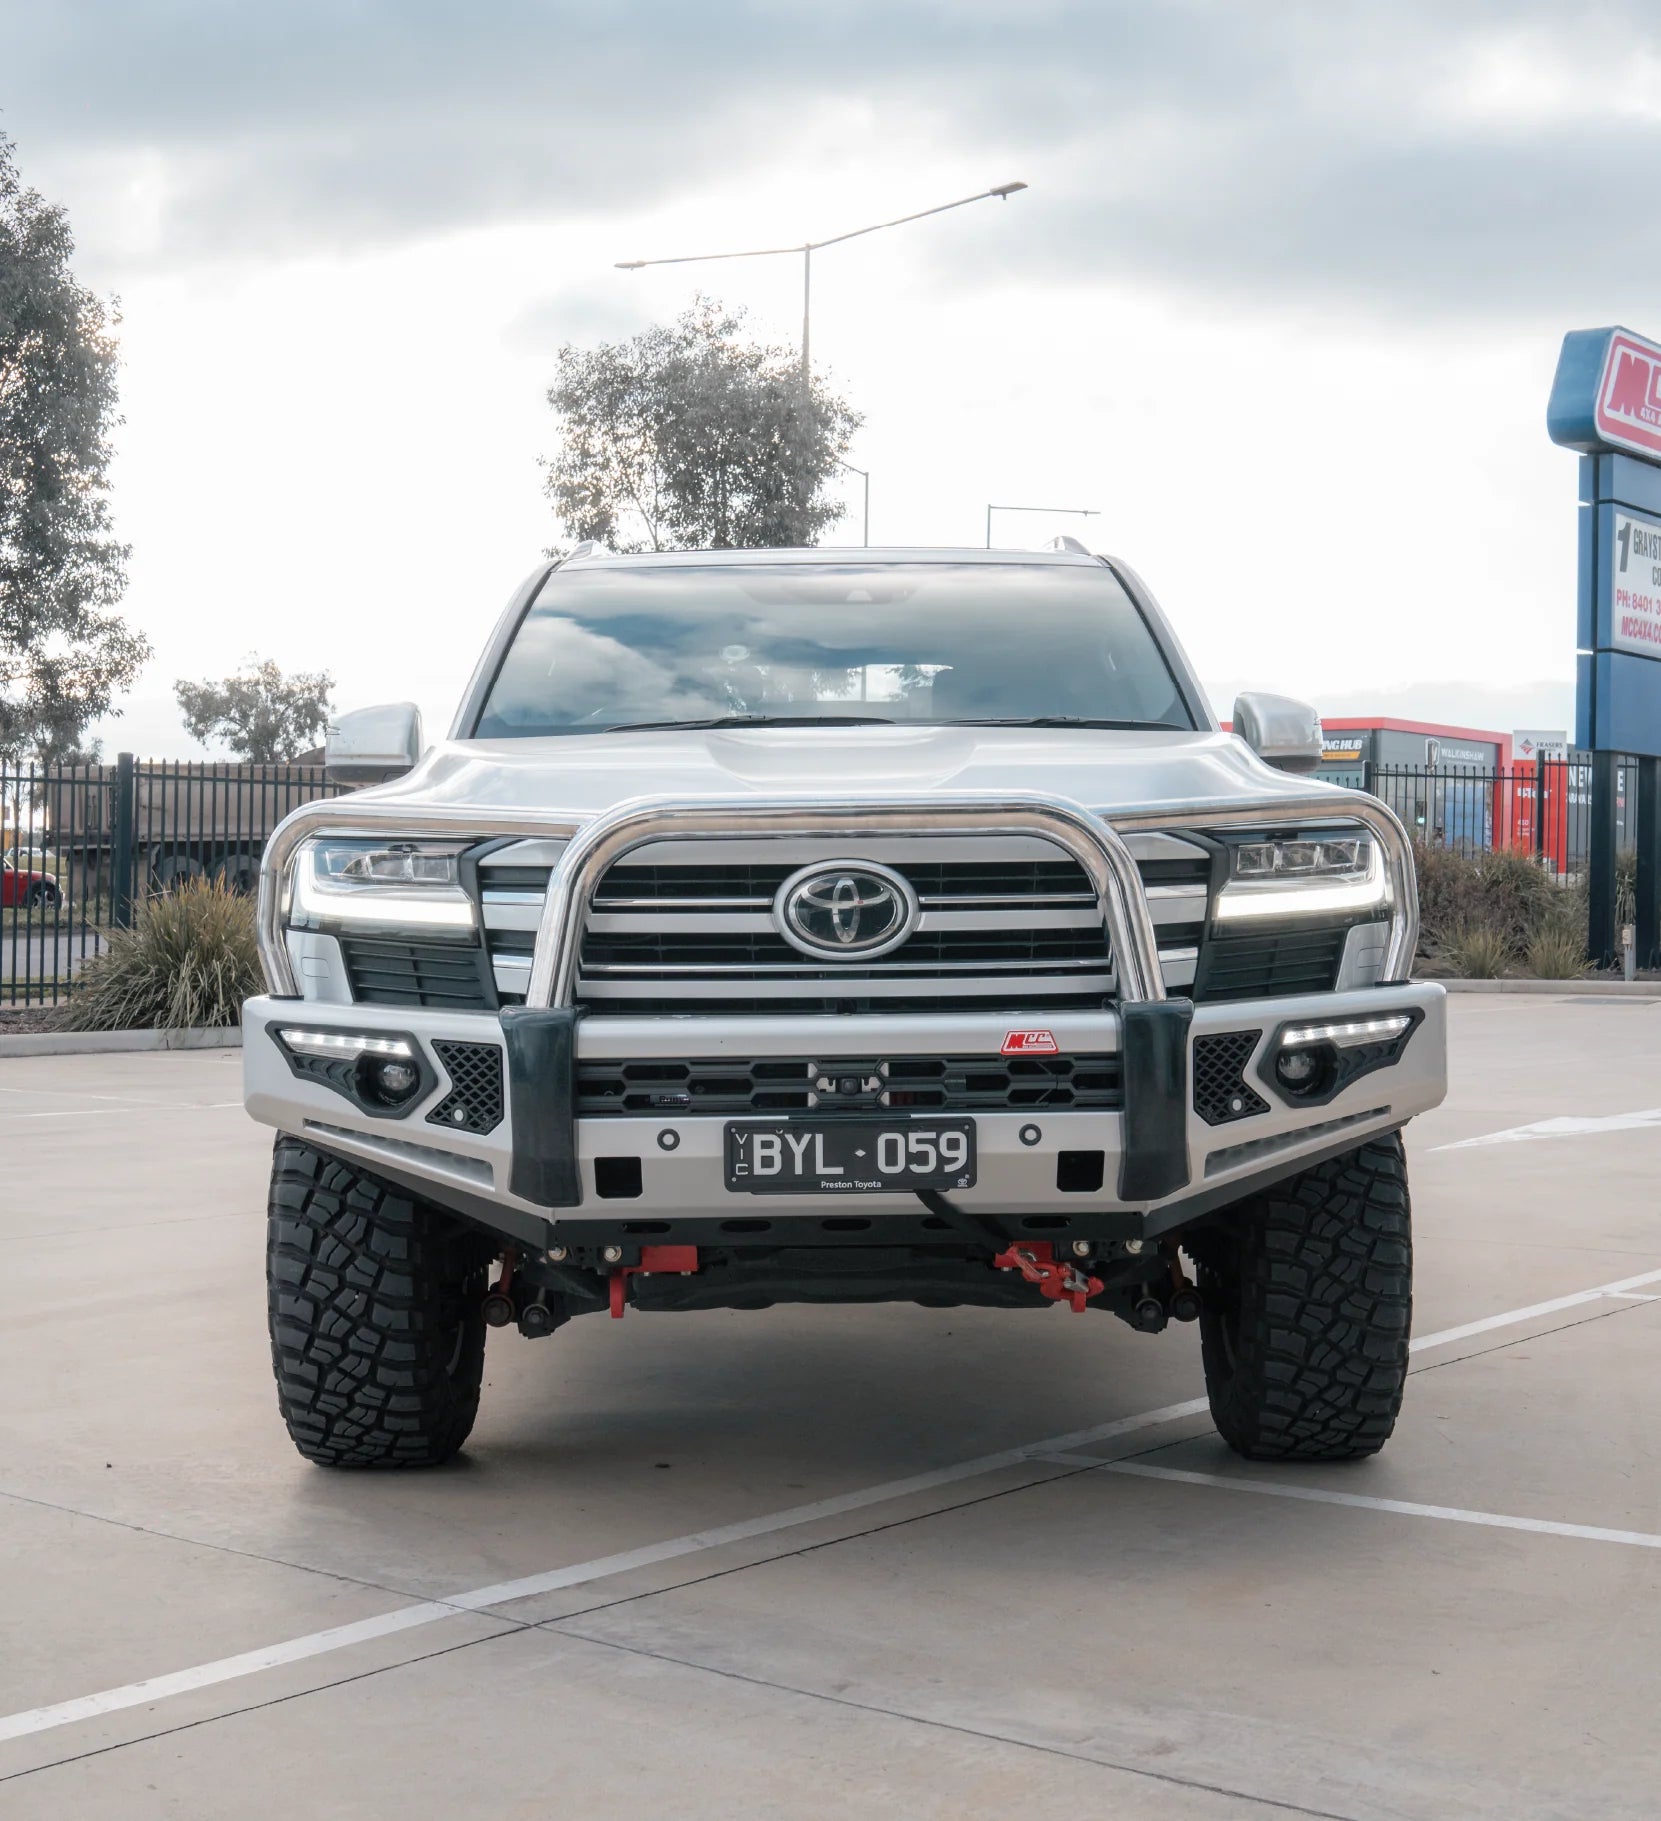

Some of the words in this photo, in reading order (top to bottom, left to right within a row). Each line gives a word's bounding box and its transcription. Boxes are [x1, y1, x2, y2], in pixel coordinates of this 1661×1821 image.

[1640, 406, 1656, 424] 4X4
[1618, 522, 1631, 573] 1
[1616, 588, 1631, 609] PH:
[1632, 592, 1653, 614] 8401
[1441, 747, 1485, 761] WALKINSHAW
[1006, 1033, 1052, 1049] MCC
[753, 1133, 844, 1176] BYL
[877, 1131, 968, 1174] 059
[820, 1181, 853, 1189] Preston
[853, 1180, 882, 1190] Toyota
